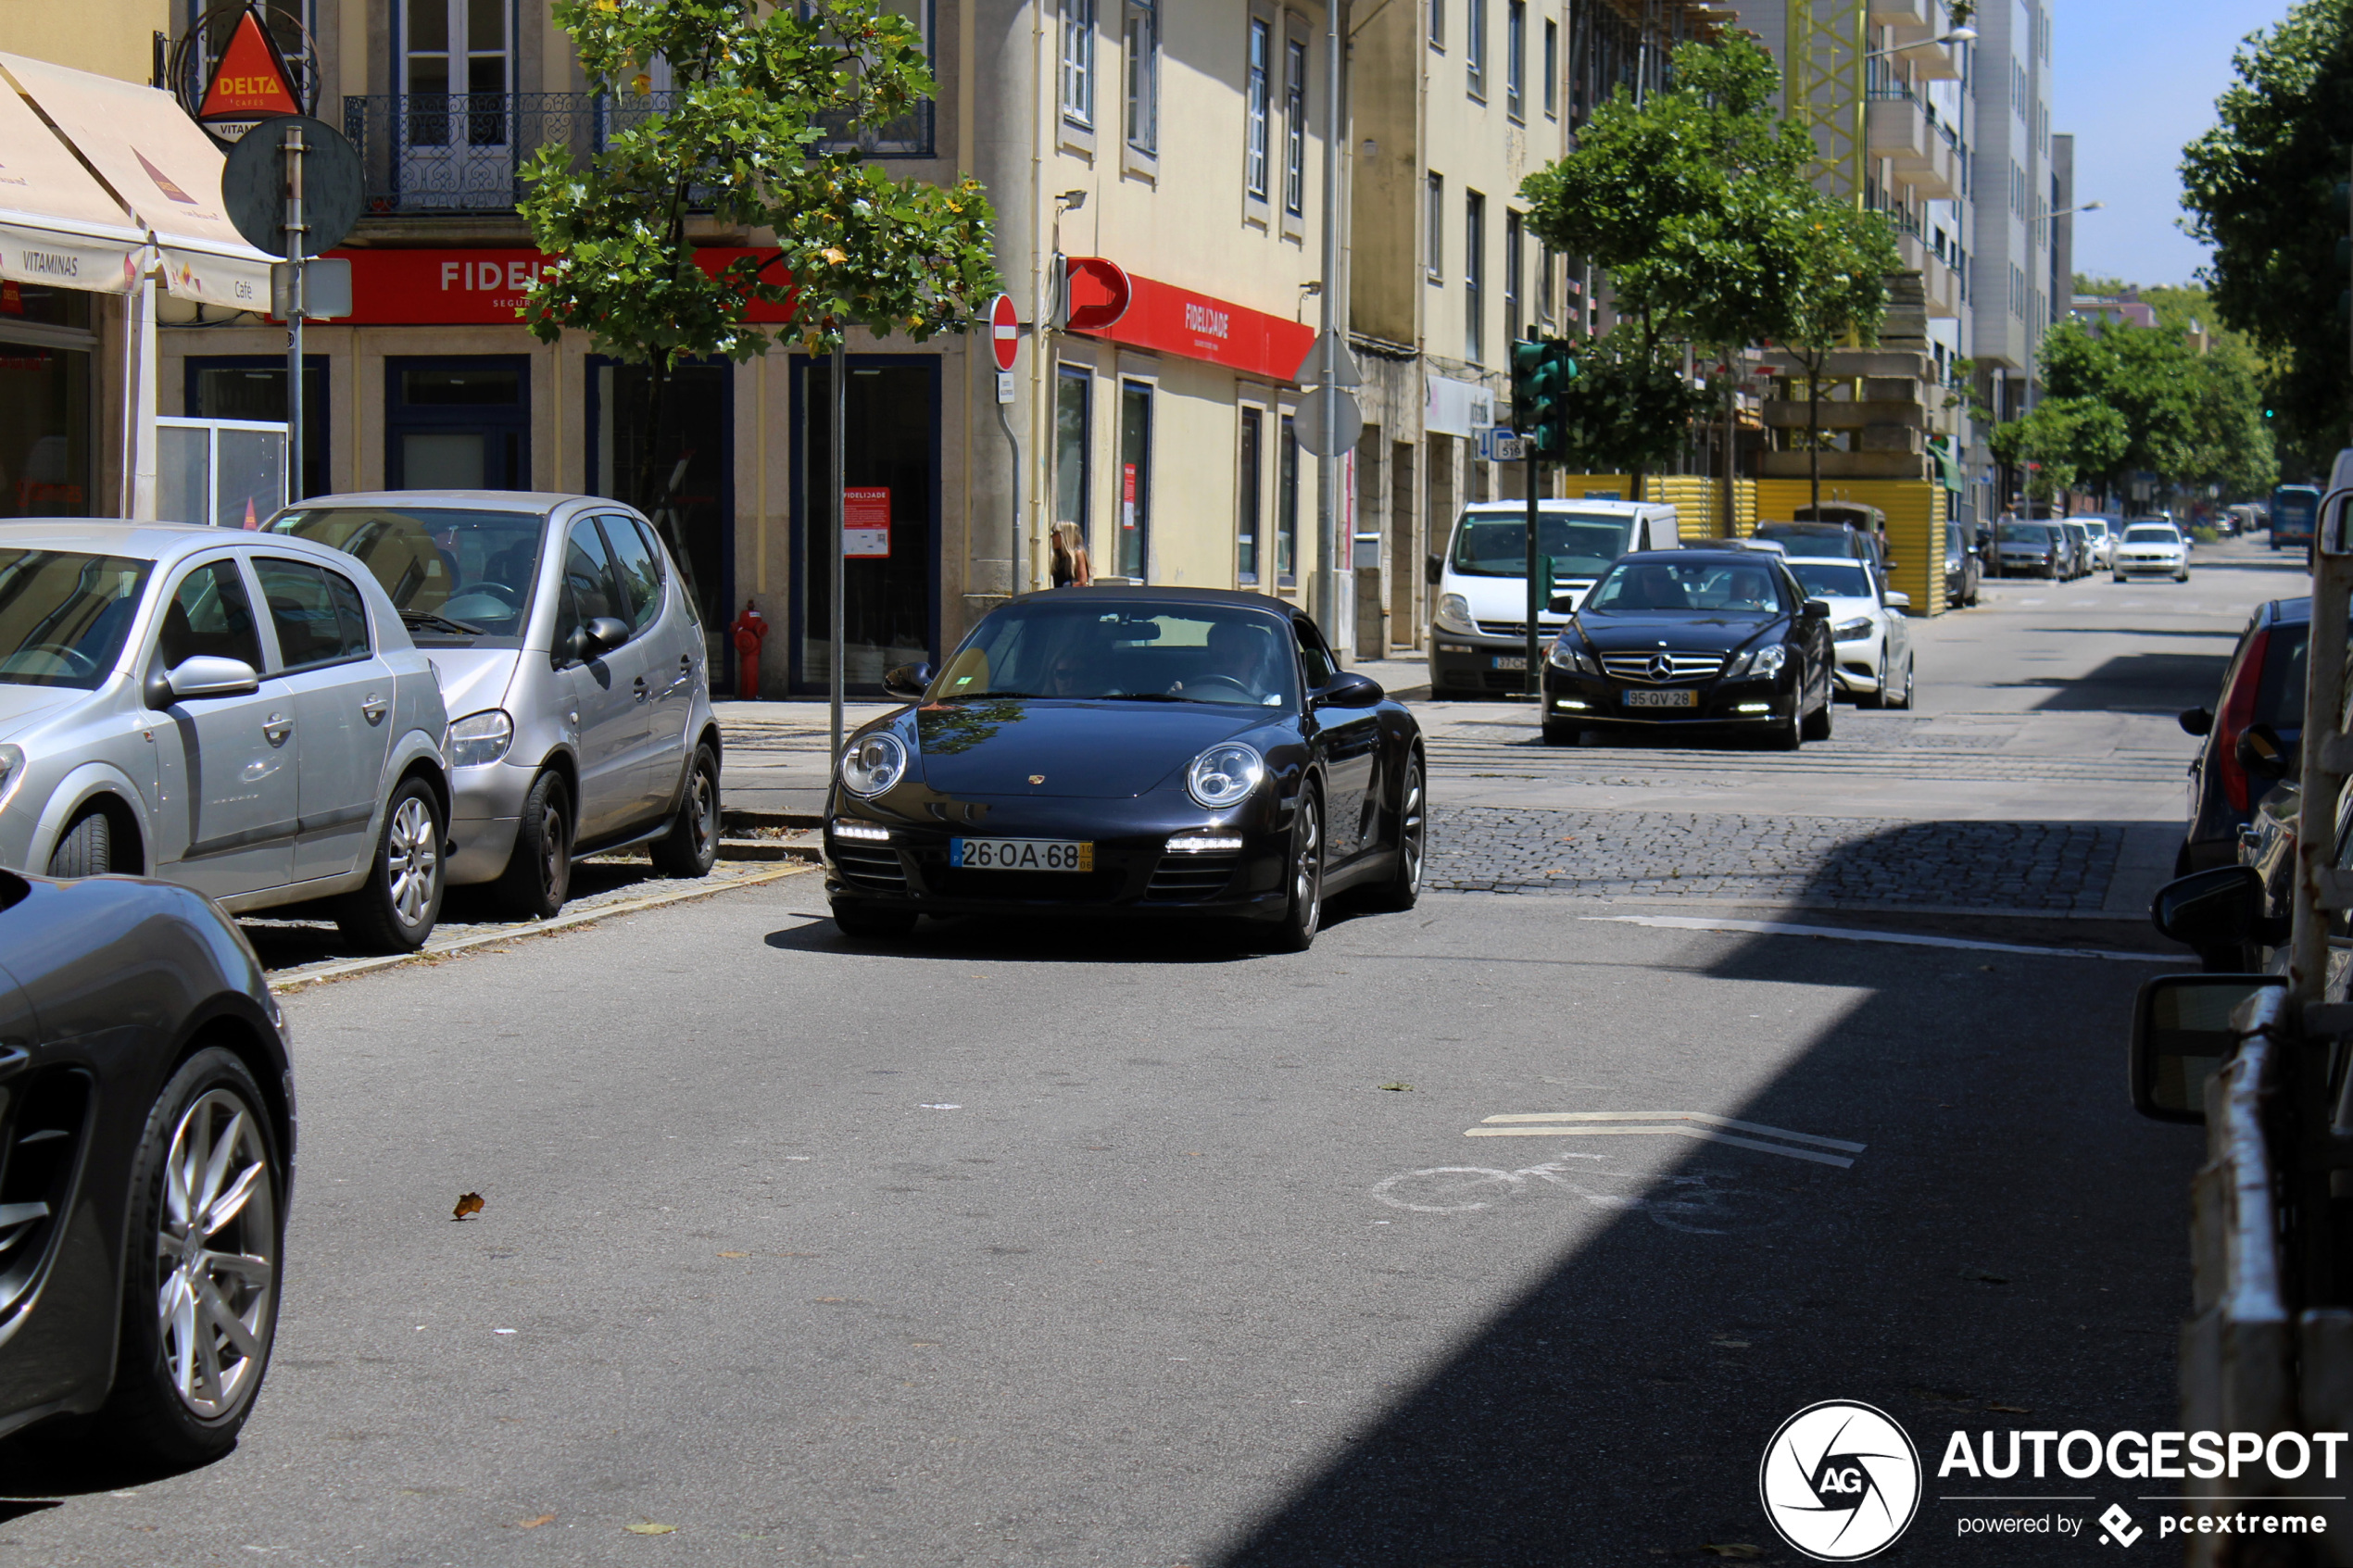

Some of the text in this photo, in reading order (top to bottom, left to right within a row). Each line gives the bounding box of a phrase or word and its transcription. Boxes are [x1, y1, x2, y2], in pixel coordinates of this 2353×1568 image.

[219, 76, 280, 95] DELTA
[235, 98, 265, 107] CAFÉS
[22, 250, 79, 278] VITAMINAS
[234, 281, 253, 300] Café
[1185, 302, 1229, 340] FIDELIDADE
[1502, 447, 1521, 457] 519
[1081, 844, 1092, 854] 10
[1080, 860, 1092, 869] 06
